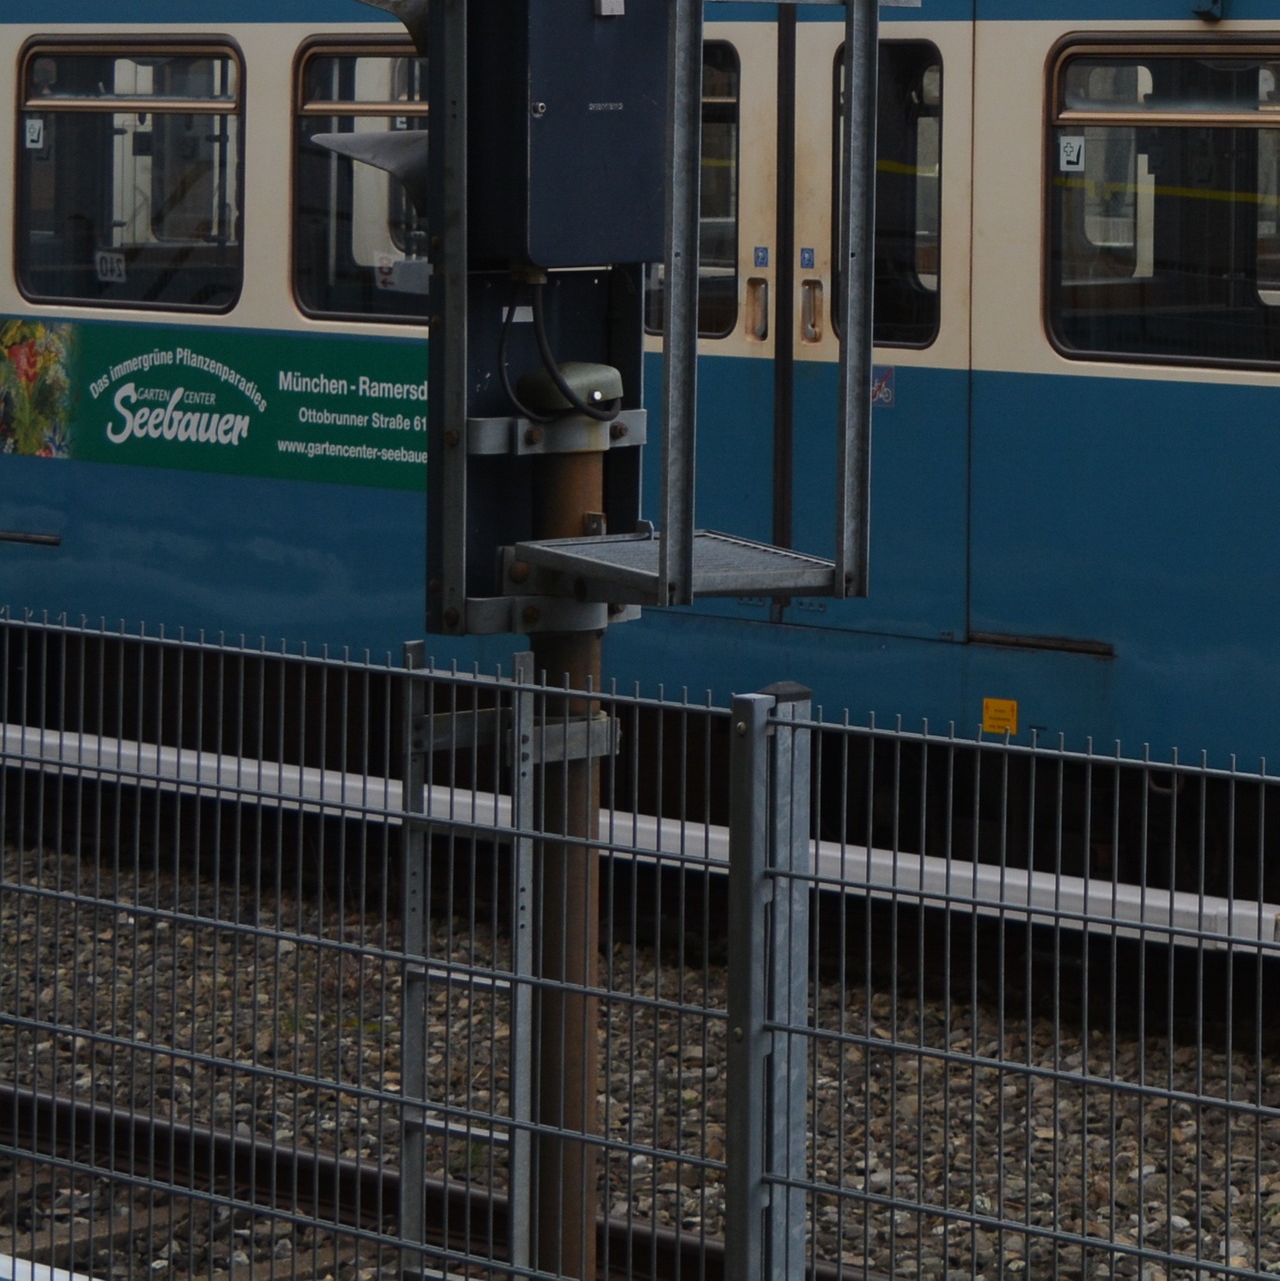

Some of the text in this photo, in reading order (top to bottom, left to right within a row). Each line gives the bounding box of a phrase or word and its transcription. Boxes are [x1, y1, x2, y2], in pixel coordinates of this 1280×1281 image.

[89, 347, 267, 413] Das immergrüne Pflanzenparadies
[278, 370, 348, 395] München
[136, 387, 216, 405] GARTEN CENTER
[106, 382, 250, 446] Seebauer
[298, 406, 369, 427] Ottobrunner
[371, 412, 411, 430] Straße
